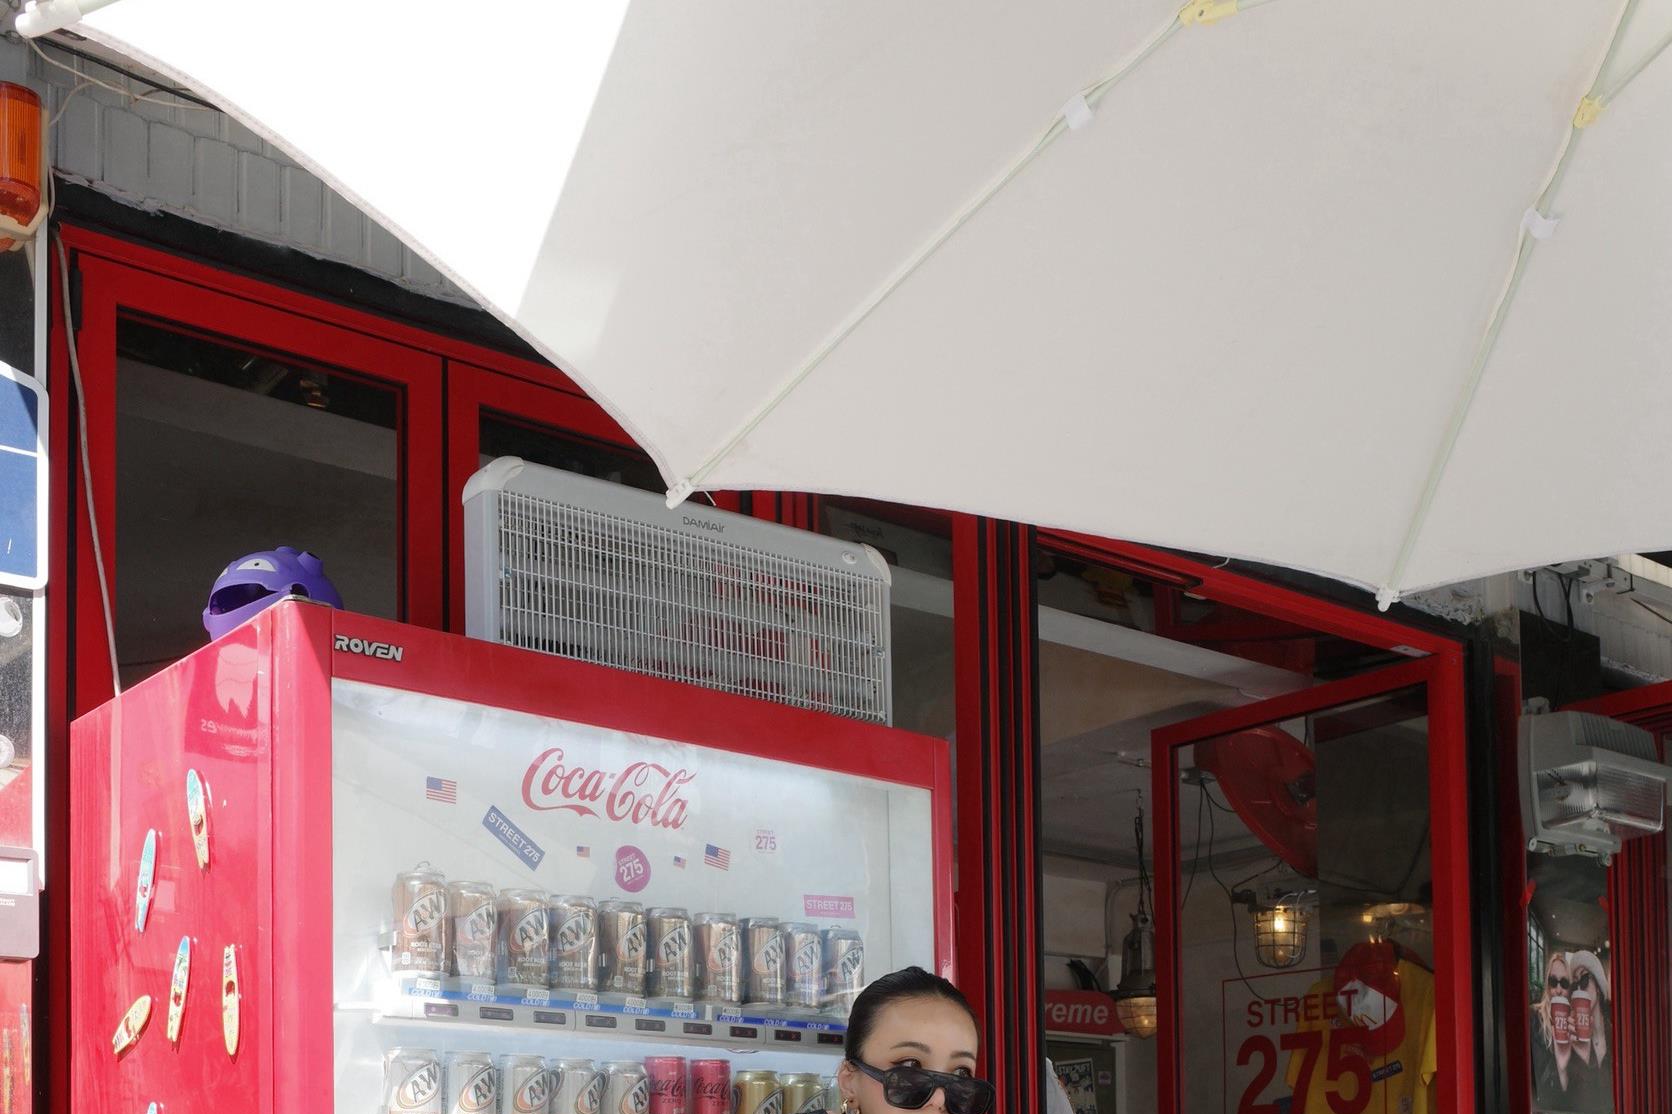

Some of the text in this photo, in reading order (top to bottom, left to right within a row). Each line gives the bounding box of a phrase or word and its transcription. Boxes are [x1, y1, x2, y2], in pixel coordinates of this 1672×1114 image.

[334, 634, 404, 662] ROVEN
[521, 747, 697, 830] Coca-Cola
[488, 812, 541, 863] STREET 275
[755, 836, 777, 850] 275
[619, 863, 644, 883] 275
[806, 900, 838, 912] STREET
[1246, 989, 1359, 1028] STREET
